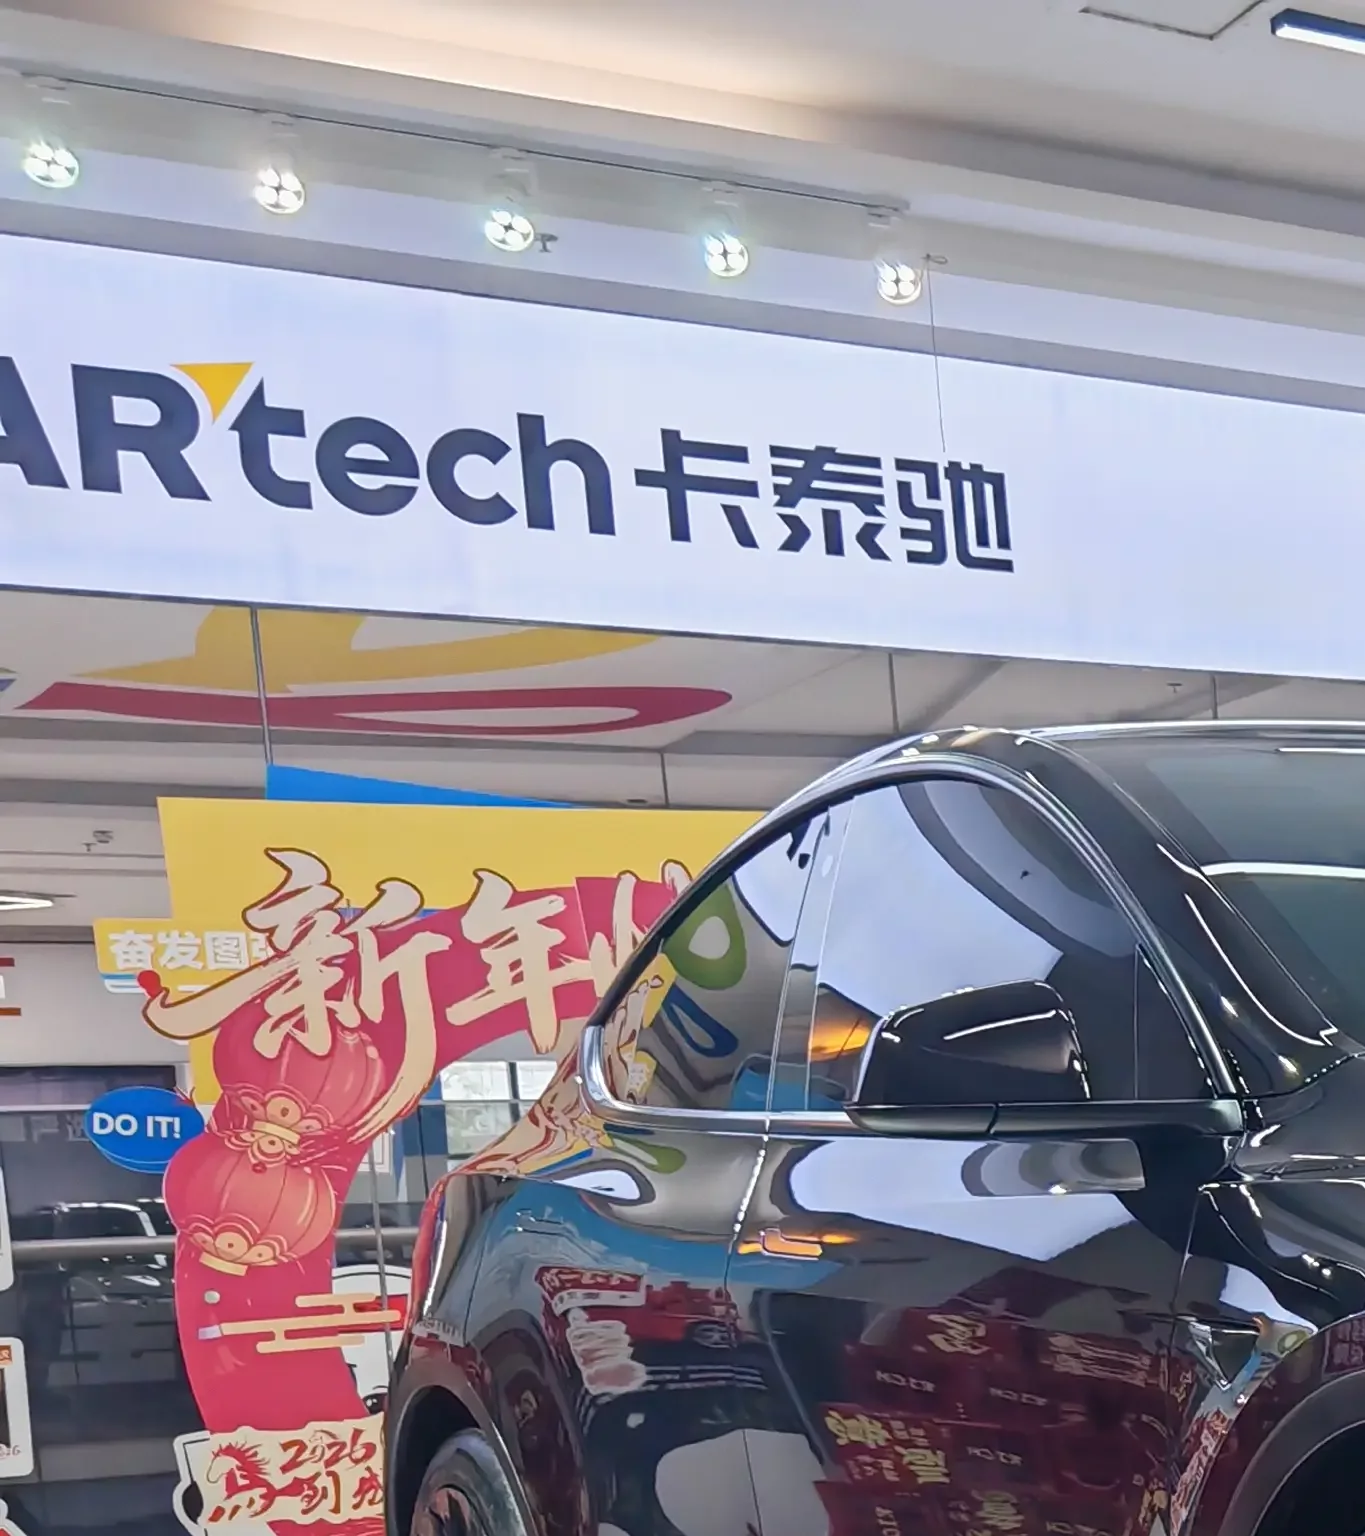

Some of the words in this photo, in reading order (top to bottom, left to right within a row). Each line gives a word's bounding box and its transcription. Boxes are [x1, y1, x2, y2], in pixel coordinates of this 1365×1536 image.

[634, 428, 1015, 573] 卡泰驰
[92, 1111, 138, 1137] DO
[146, 1115, 181, 1139] IT!
